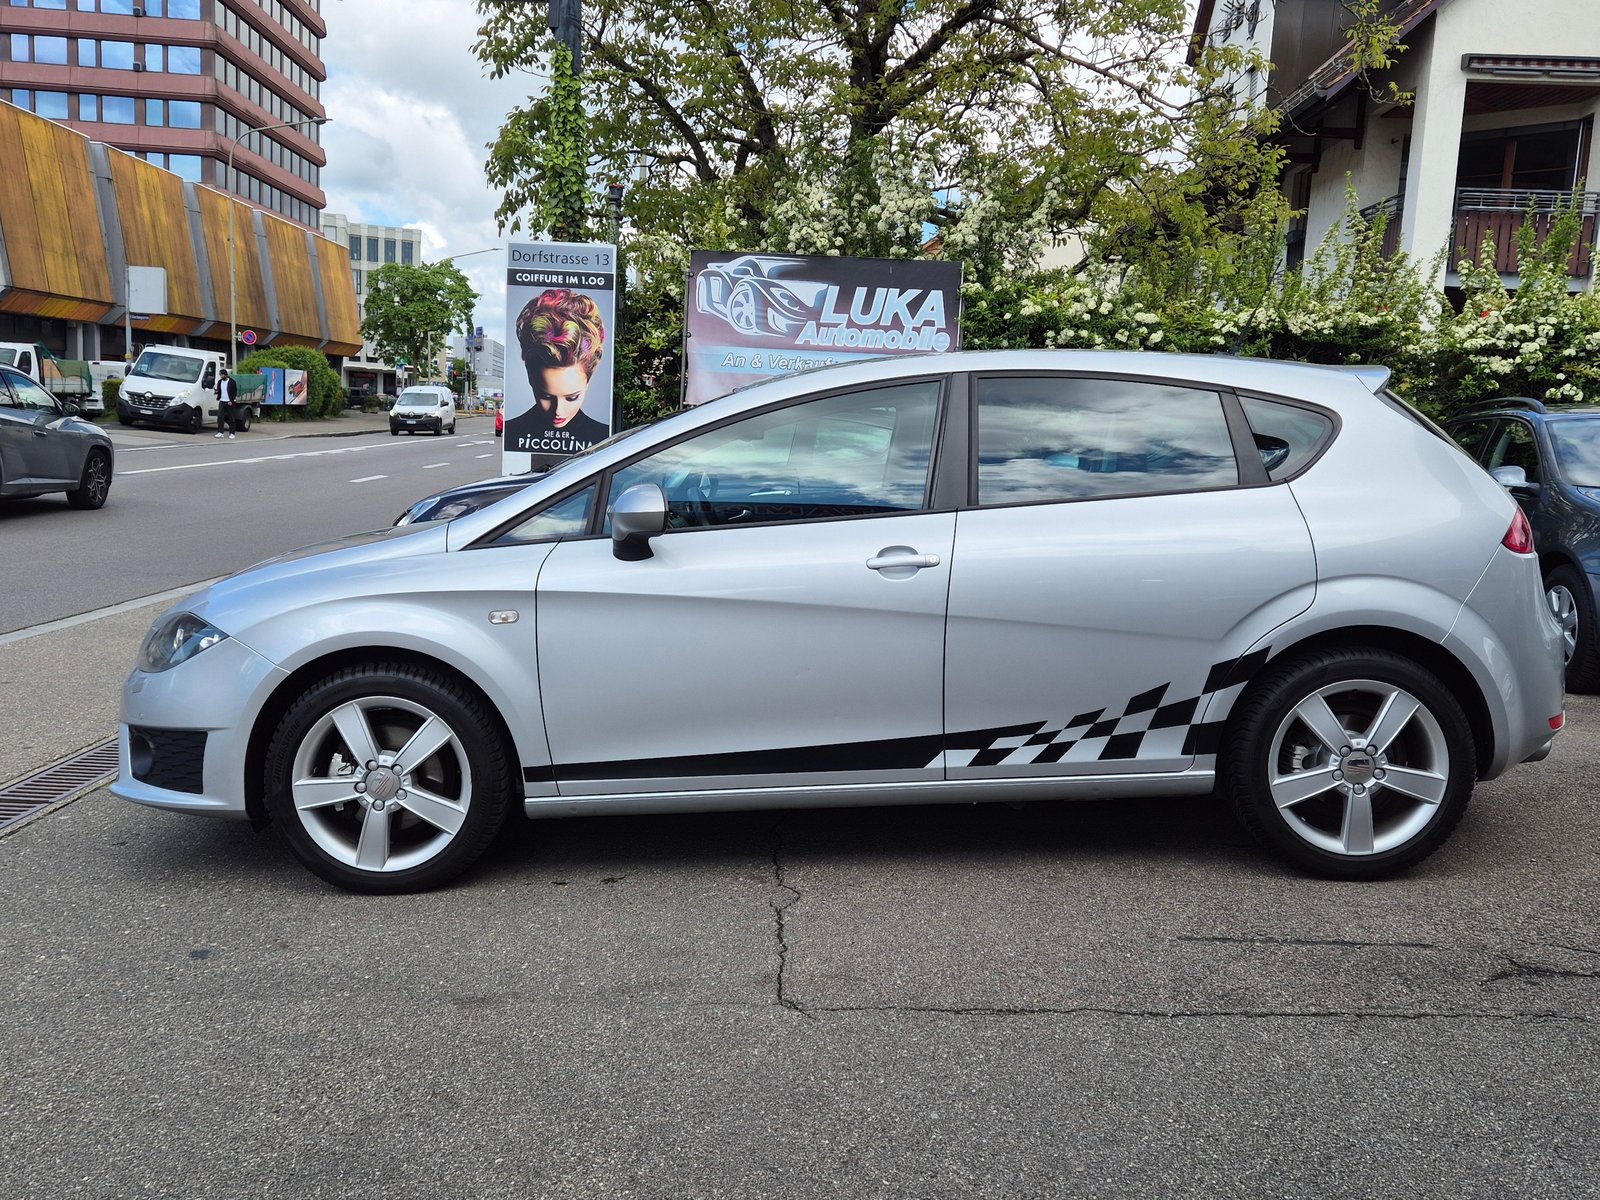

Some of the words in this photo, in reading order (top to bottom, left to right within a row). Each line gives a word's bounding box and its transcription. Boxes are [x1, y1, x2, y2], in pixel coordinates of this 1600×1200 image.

[512, 249, 589, 265] Dorfstrasse
[595, 253, 610, 266] 13
[516, 273, 563, 283] COIFFURE
[566, 275, 578, 284] IM
[581, 276, 605, 285] 1.OG
[820, 285, 946, 328] LUKA
[795, 320, 951, 352] Automobile
[721, 352, 746, 368] An
[750, 353, 763, 369] &
[544, 430, 554, 438] SIE
[561, 431, 570, 439] ER
